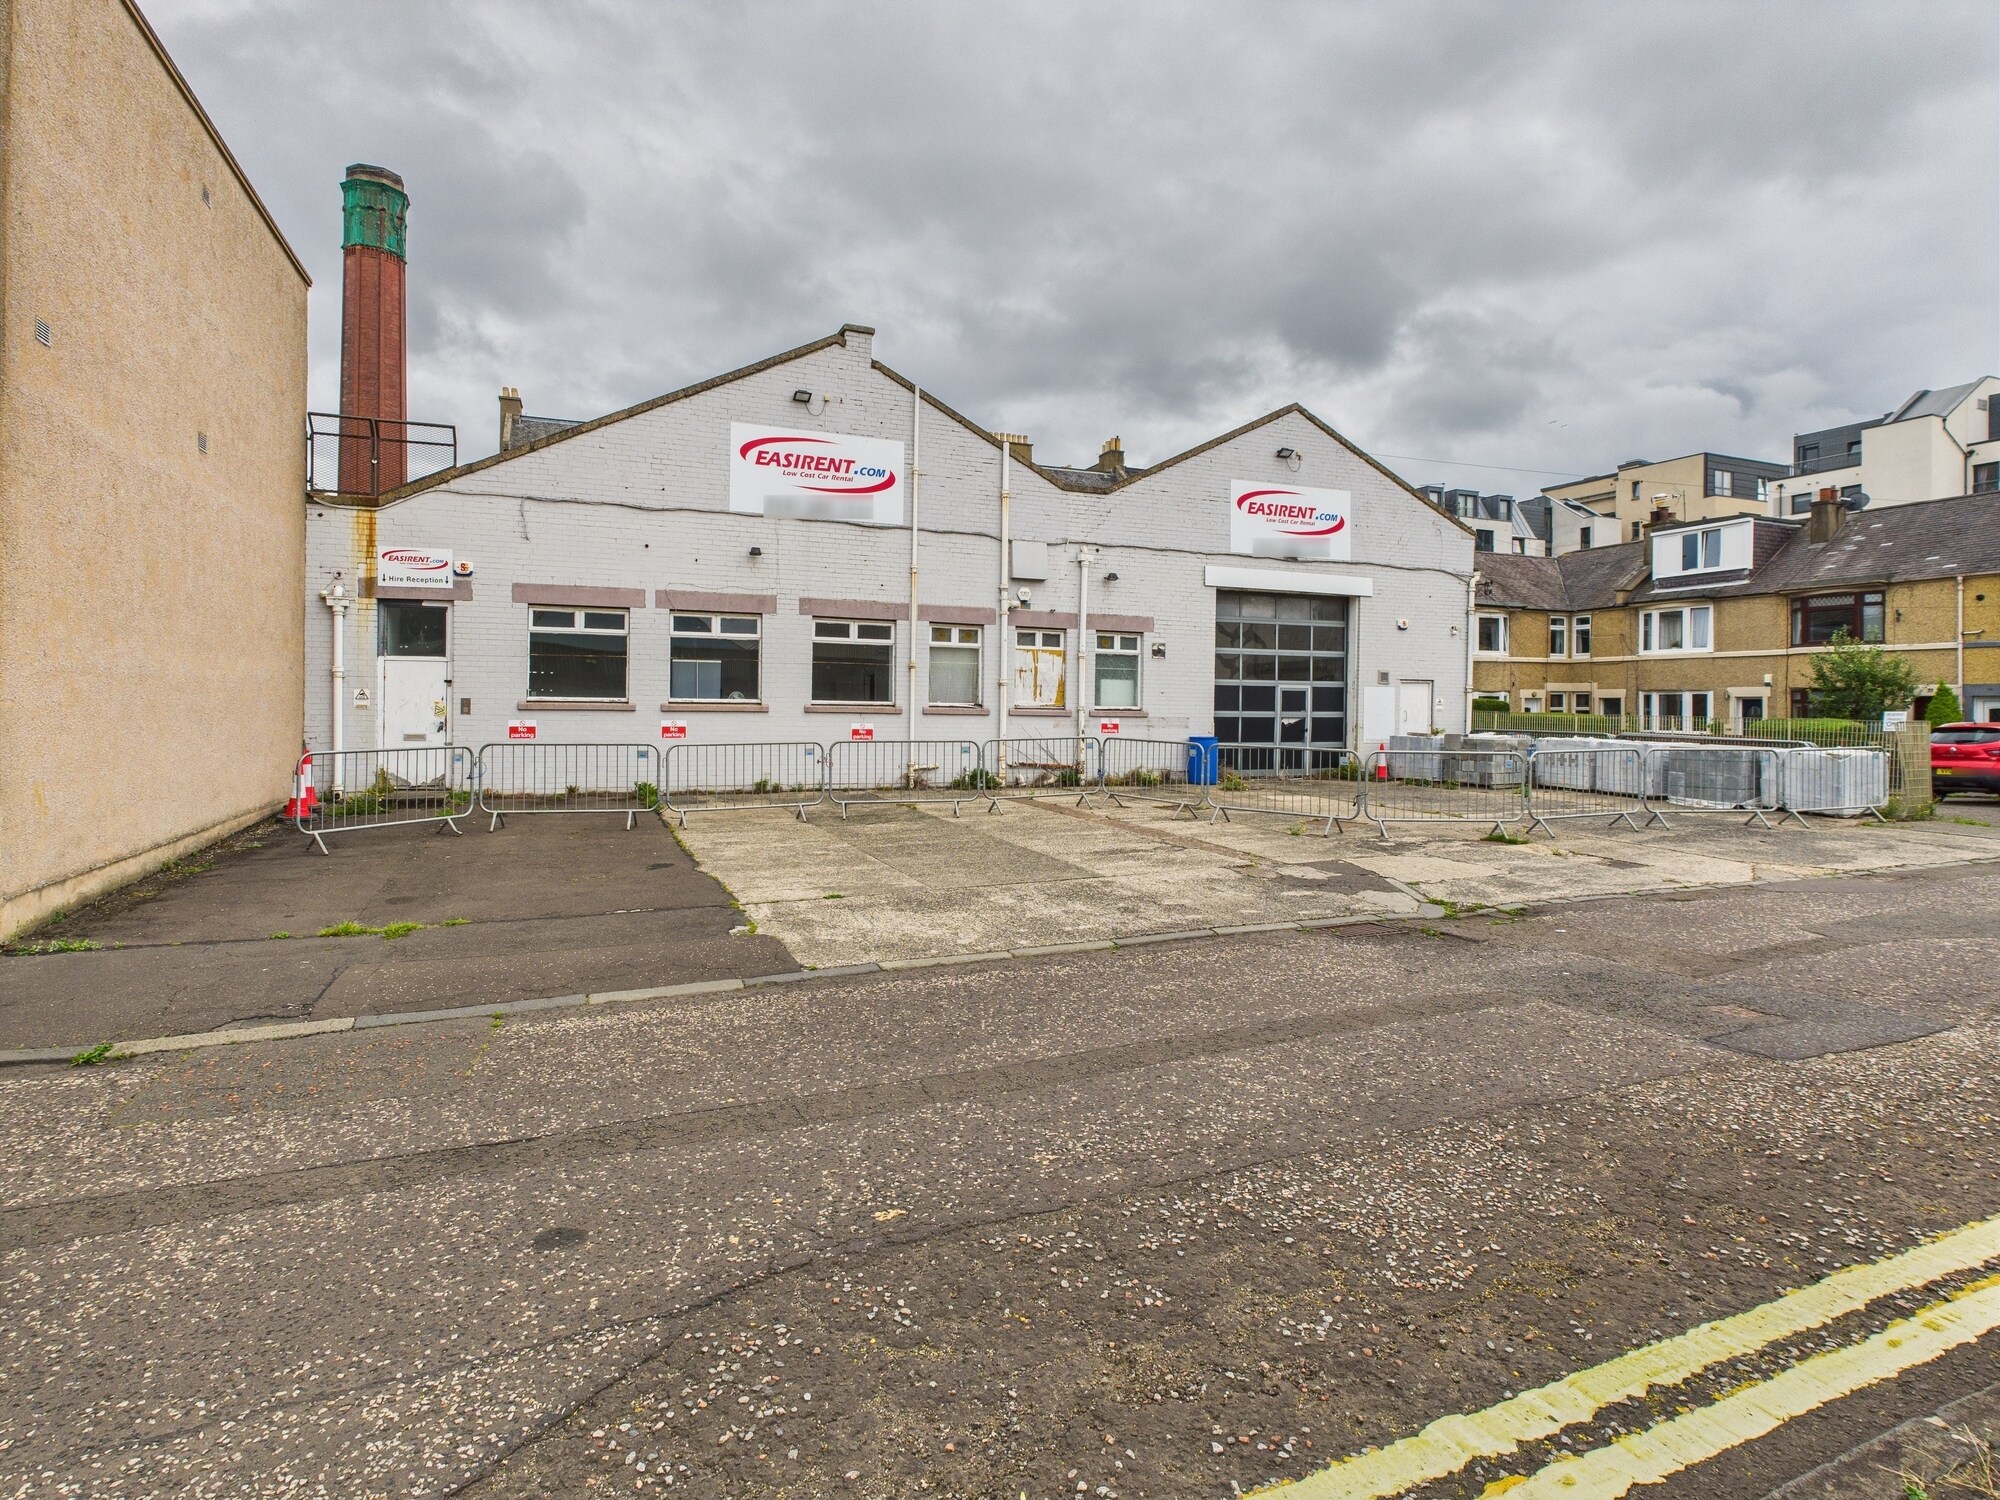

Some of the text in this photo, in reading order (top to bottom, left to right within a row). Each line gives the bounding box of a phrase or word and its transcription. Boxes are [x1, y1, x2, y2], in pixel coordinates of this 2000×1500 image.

[800, 471, 815, 479] Cost
[818, 472, 829, 480] Car
[831, 474, 854, 482] Rental
[406, 576, 443, 584] Reception
